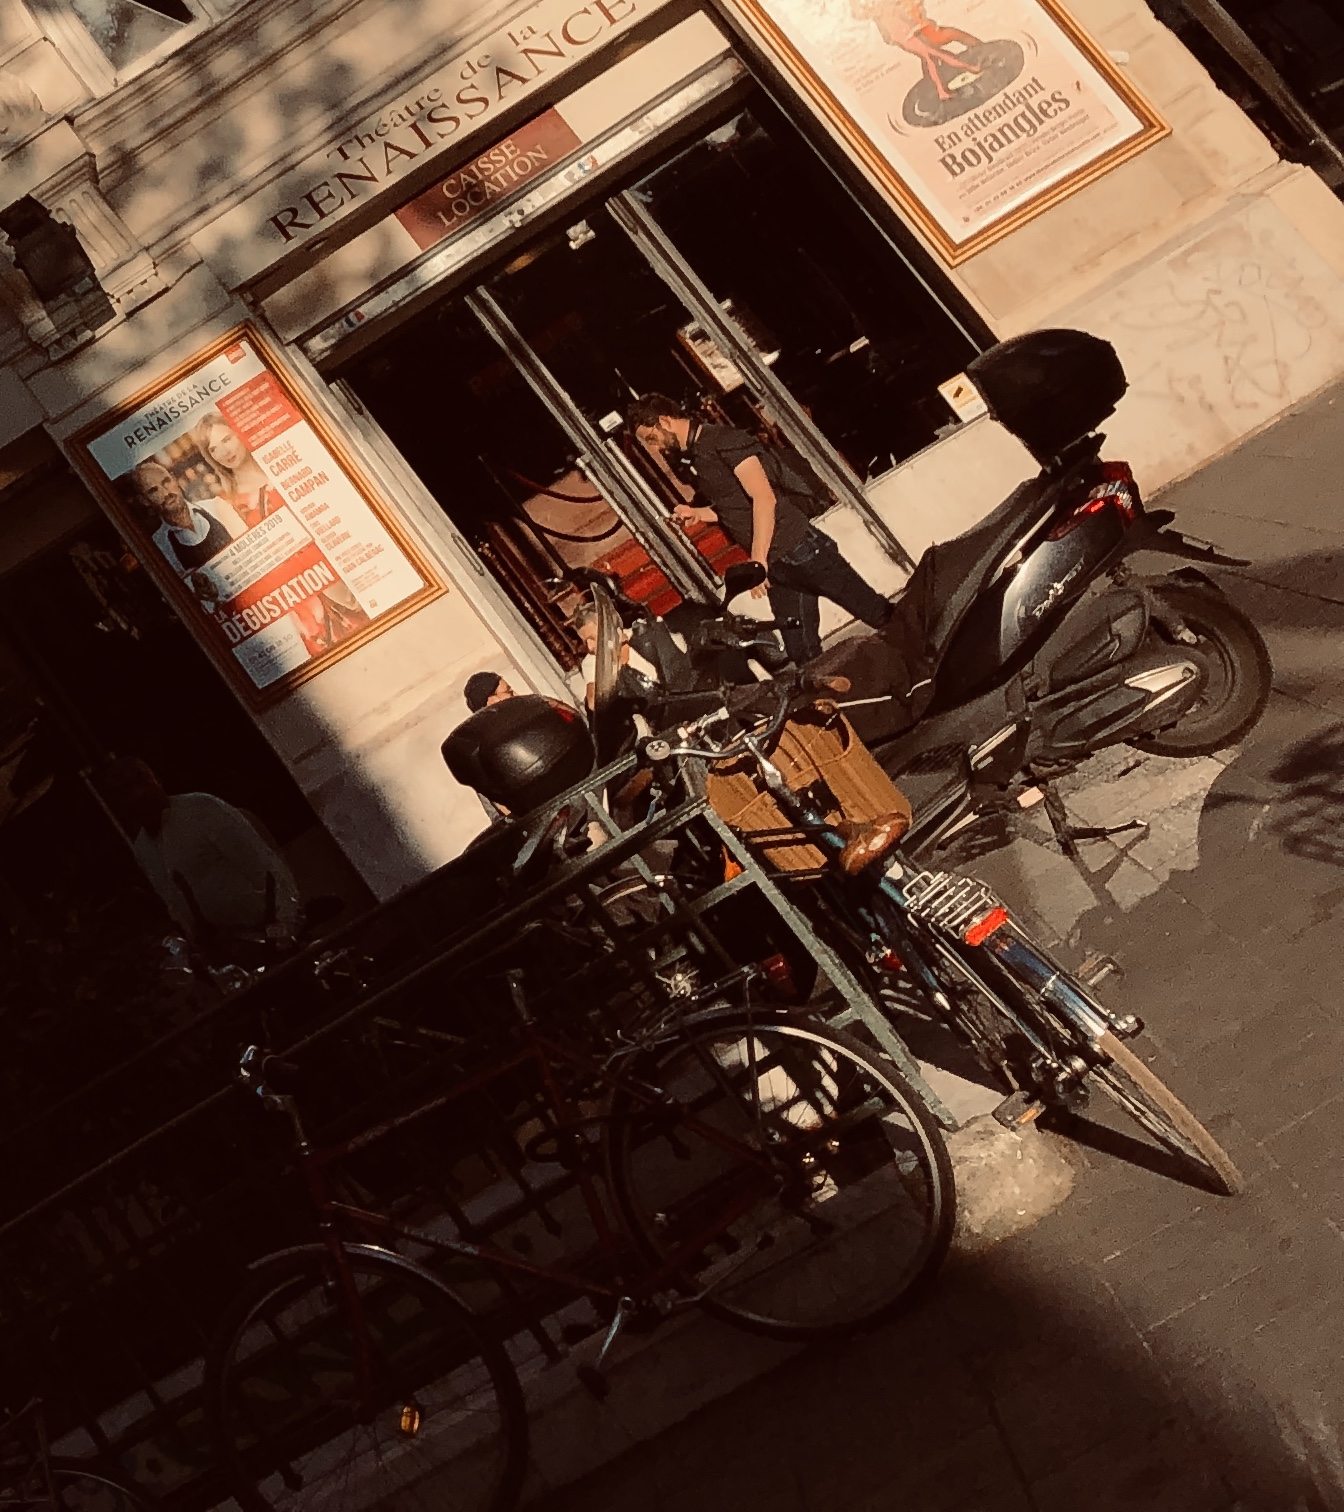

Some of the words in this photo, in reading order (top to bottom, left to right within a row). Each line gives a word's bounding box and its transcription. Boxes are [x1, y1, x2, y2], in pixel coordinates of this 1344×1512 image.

[326, 85, 444, 162] Théâtre
[459, 50, 493, 82] de
[509, 22, 537, 48] la
[933, 127, 962, 153] En
[959, 75, 1046, 138] attendant
[441, 138, 522, 199] CAISSE
[938, 88, 1071, 179] Bojangles
[435, 143, 549, 228] LOCATION
[123, 372, 231, 448] RENAISSANCE
[287, 470, 329, 502] CAMPAN
[233, 525, 266, 553] MOLIÈRES
[263, 513, 283, 531] 2019
[214, 610, 228, 623] LA
[221, 560, 335, 643] DÉGUSTATION
